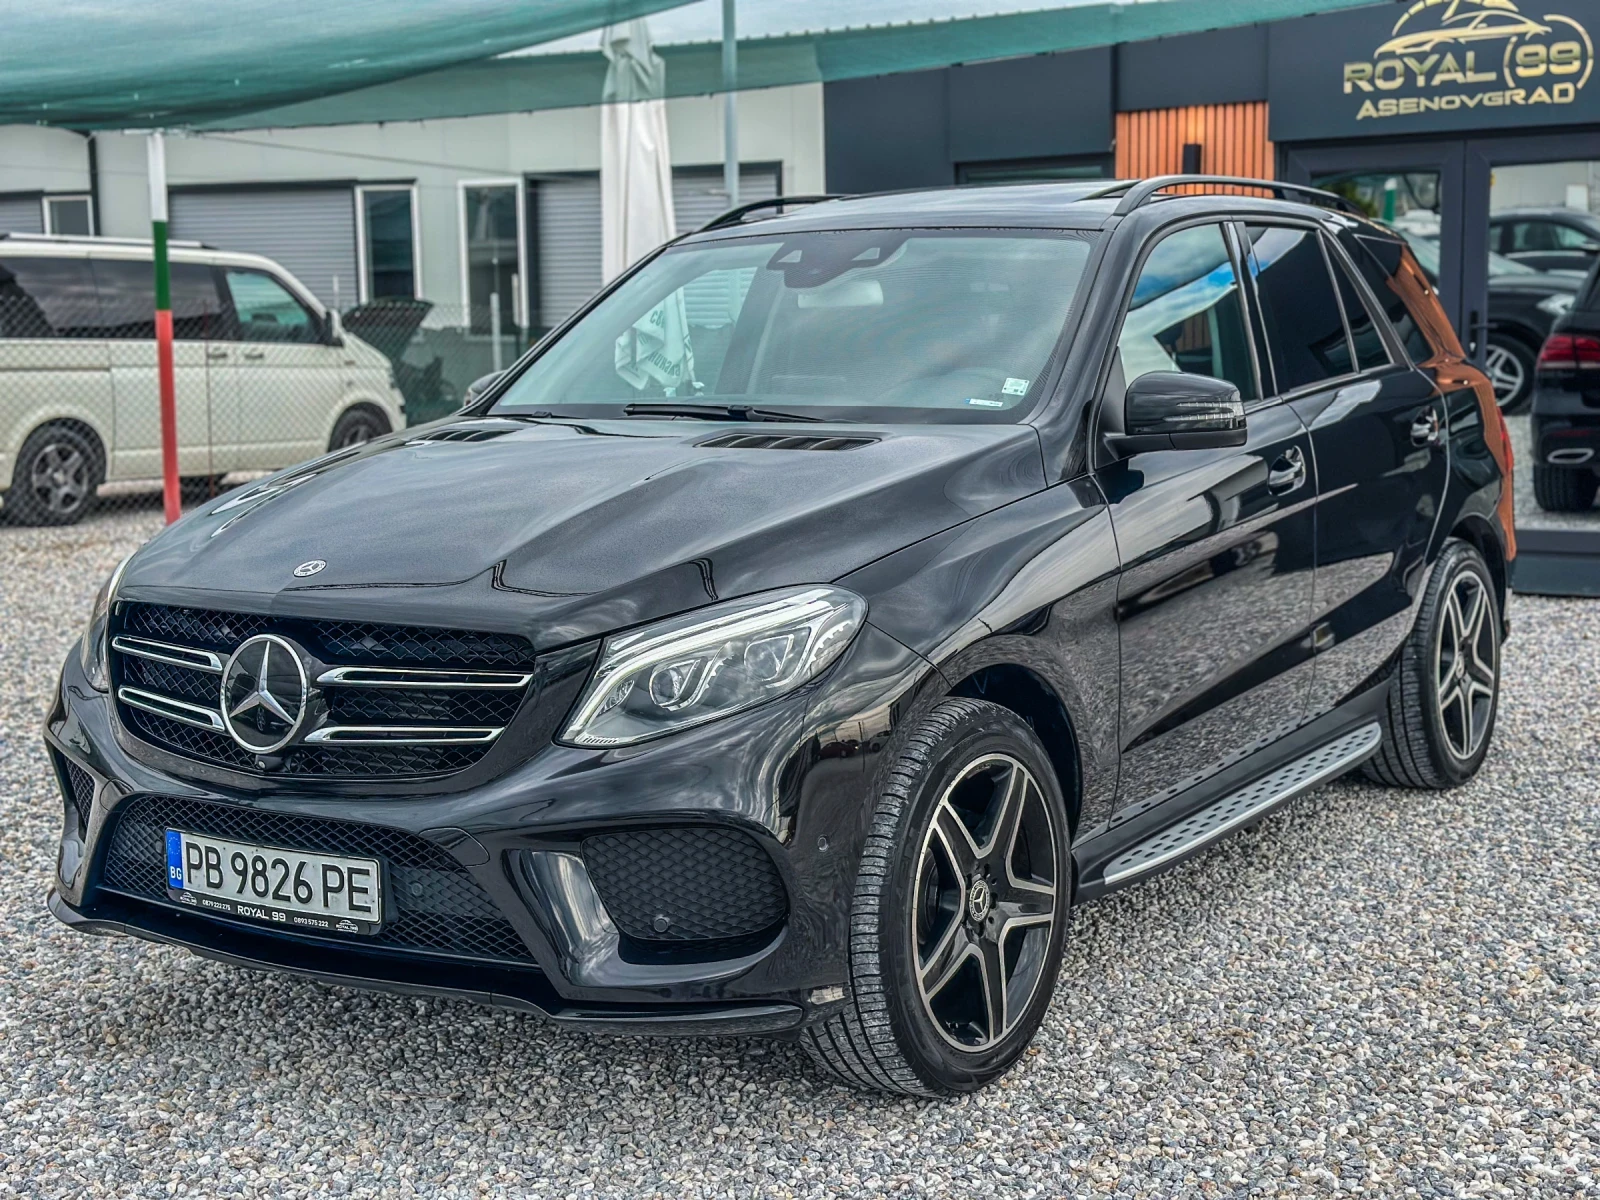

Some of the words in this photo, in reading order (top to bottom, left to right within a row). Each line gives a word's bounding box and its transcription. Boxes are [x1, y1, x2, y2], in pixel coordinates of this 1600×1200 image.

[1343, 51, 1497, 94] ROYAL
[1515, 41, 1582, 78] 99
[1356, 82, 1576, 120] ASENOVGRAD
[170, 866, 182, 880] BG
[185, 841, 224, 889] PB
[230, 851, 313, 904] 9826
[321, 863, 372, 913] PE
[237, 905, 269, 920] ROYAL
[272, 911, 286, 922] 99
